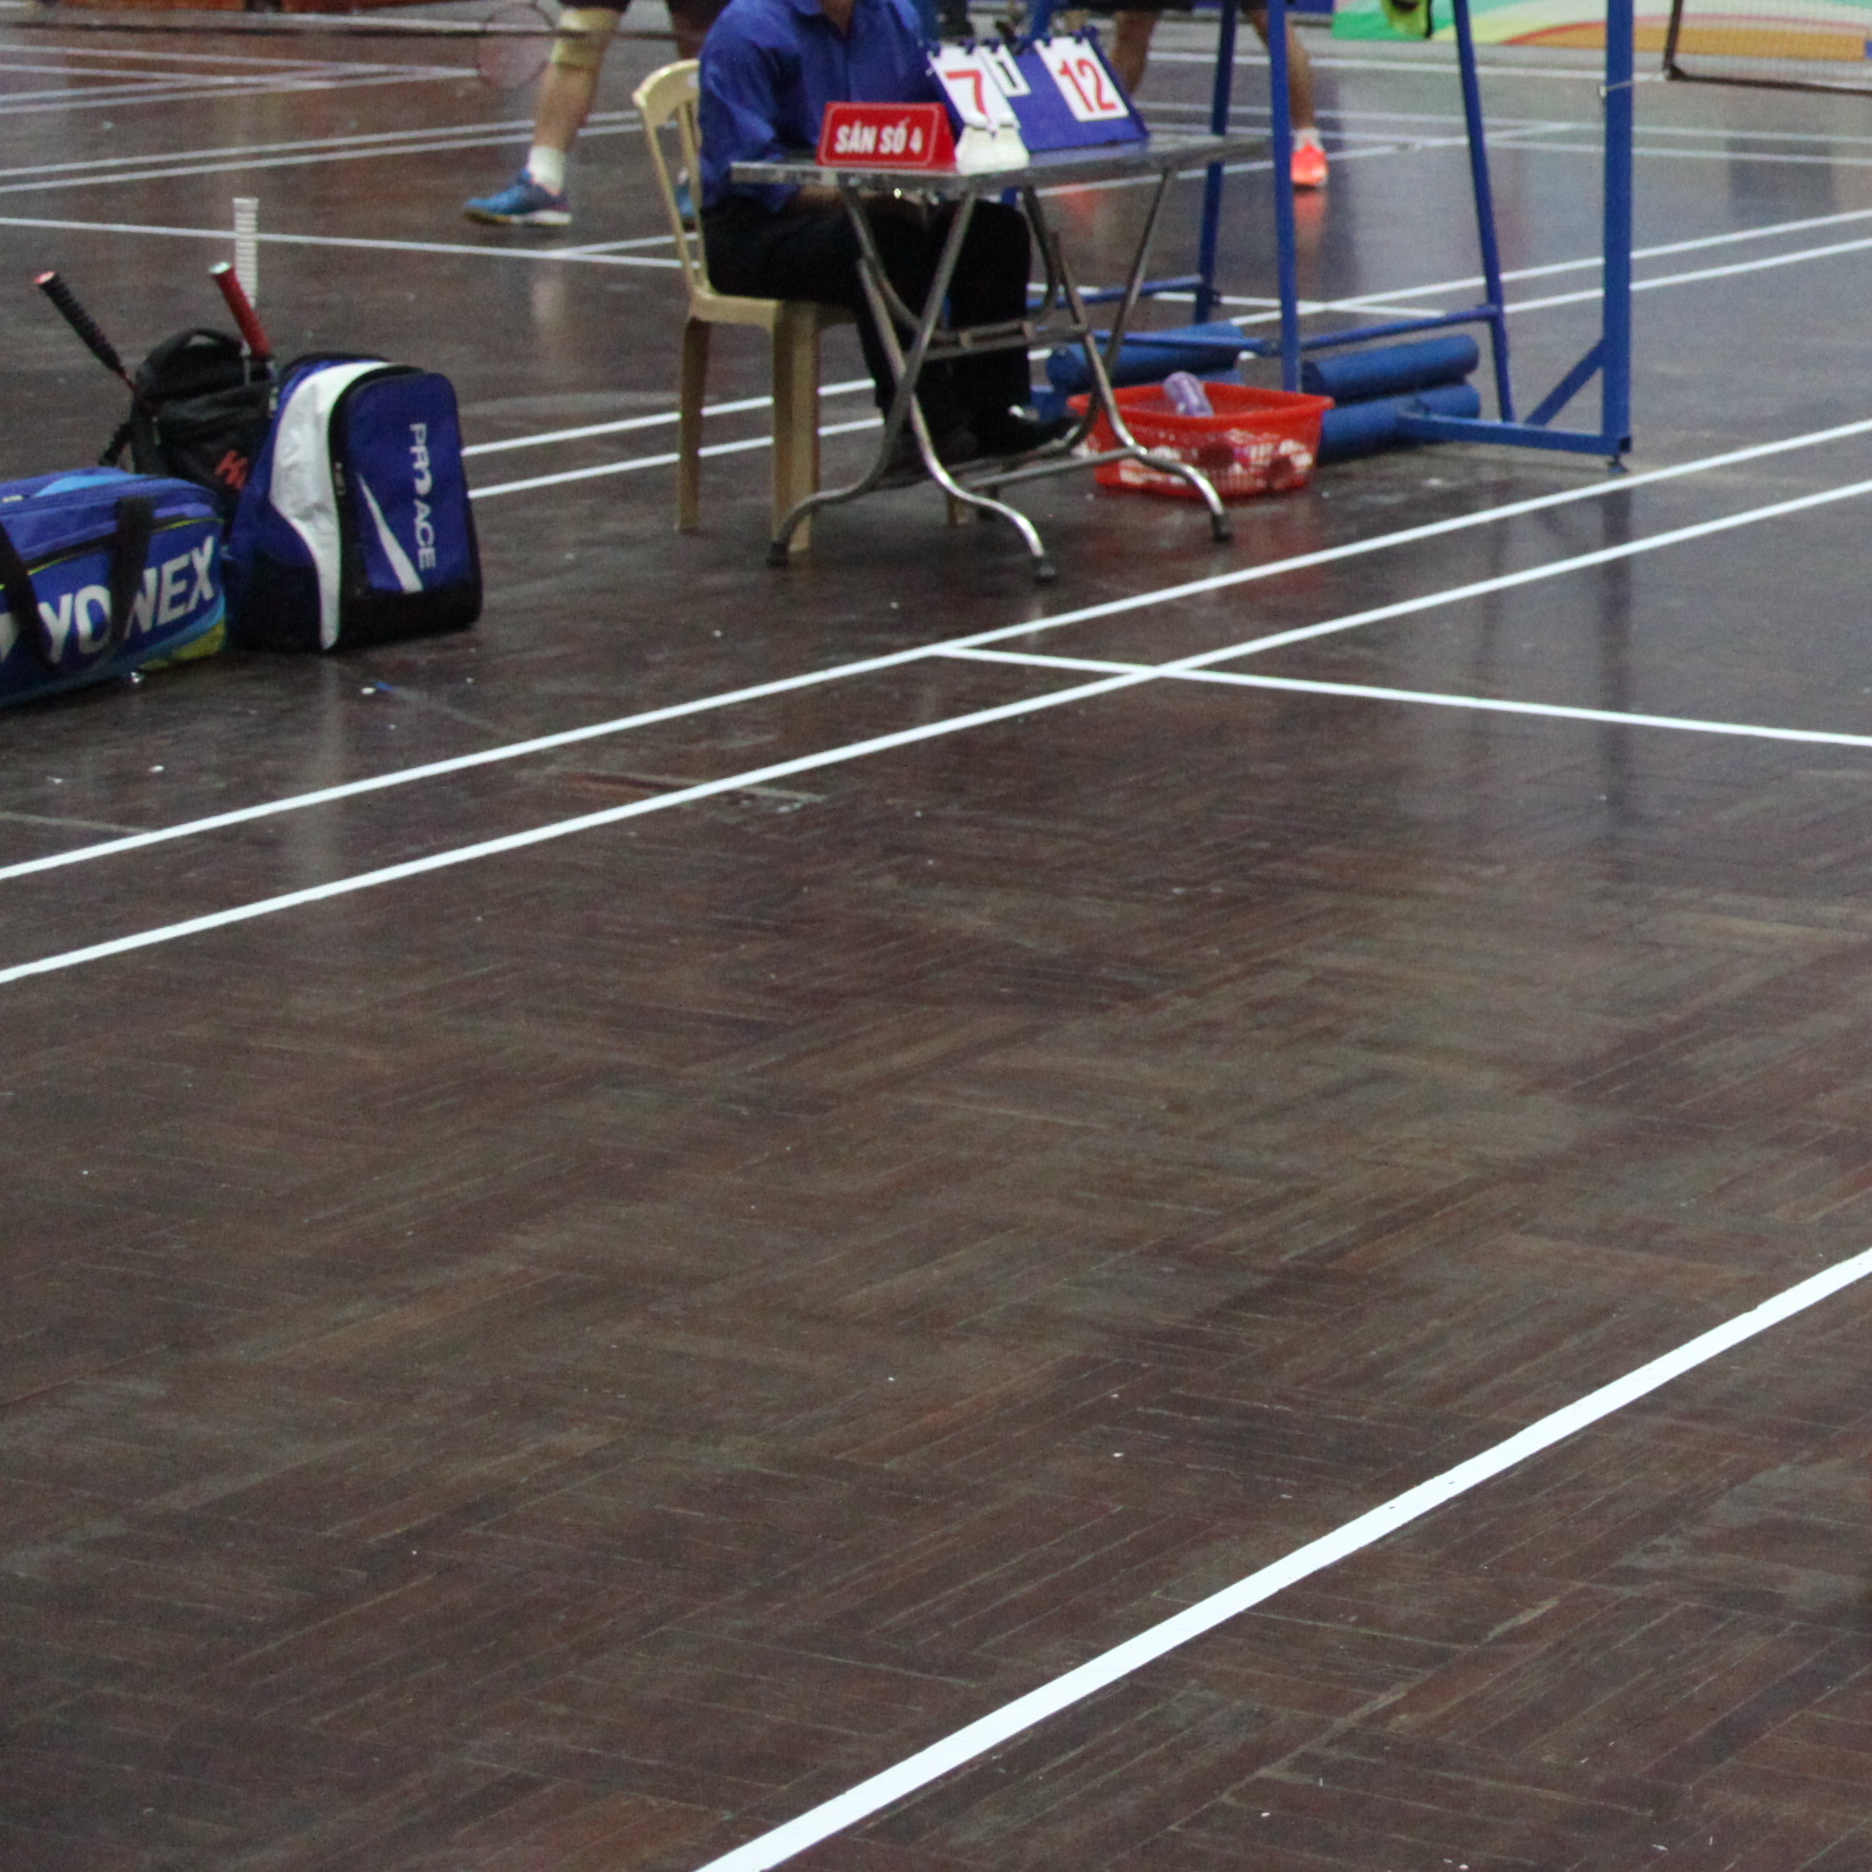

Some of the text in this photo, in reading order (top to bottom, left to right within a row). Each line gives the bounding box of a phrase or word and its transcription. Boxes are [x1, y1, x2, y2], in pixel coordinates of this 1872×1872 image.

[944, 68, 990, 119] 7
[1057, 58, 1118, 113] 12
[879, 115, 911, 154] SỐ
[909, 127, 923, 154] 4
[412, 497, 437, 571] ACE
[37, 535, 217, 665] YONEX
